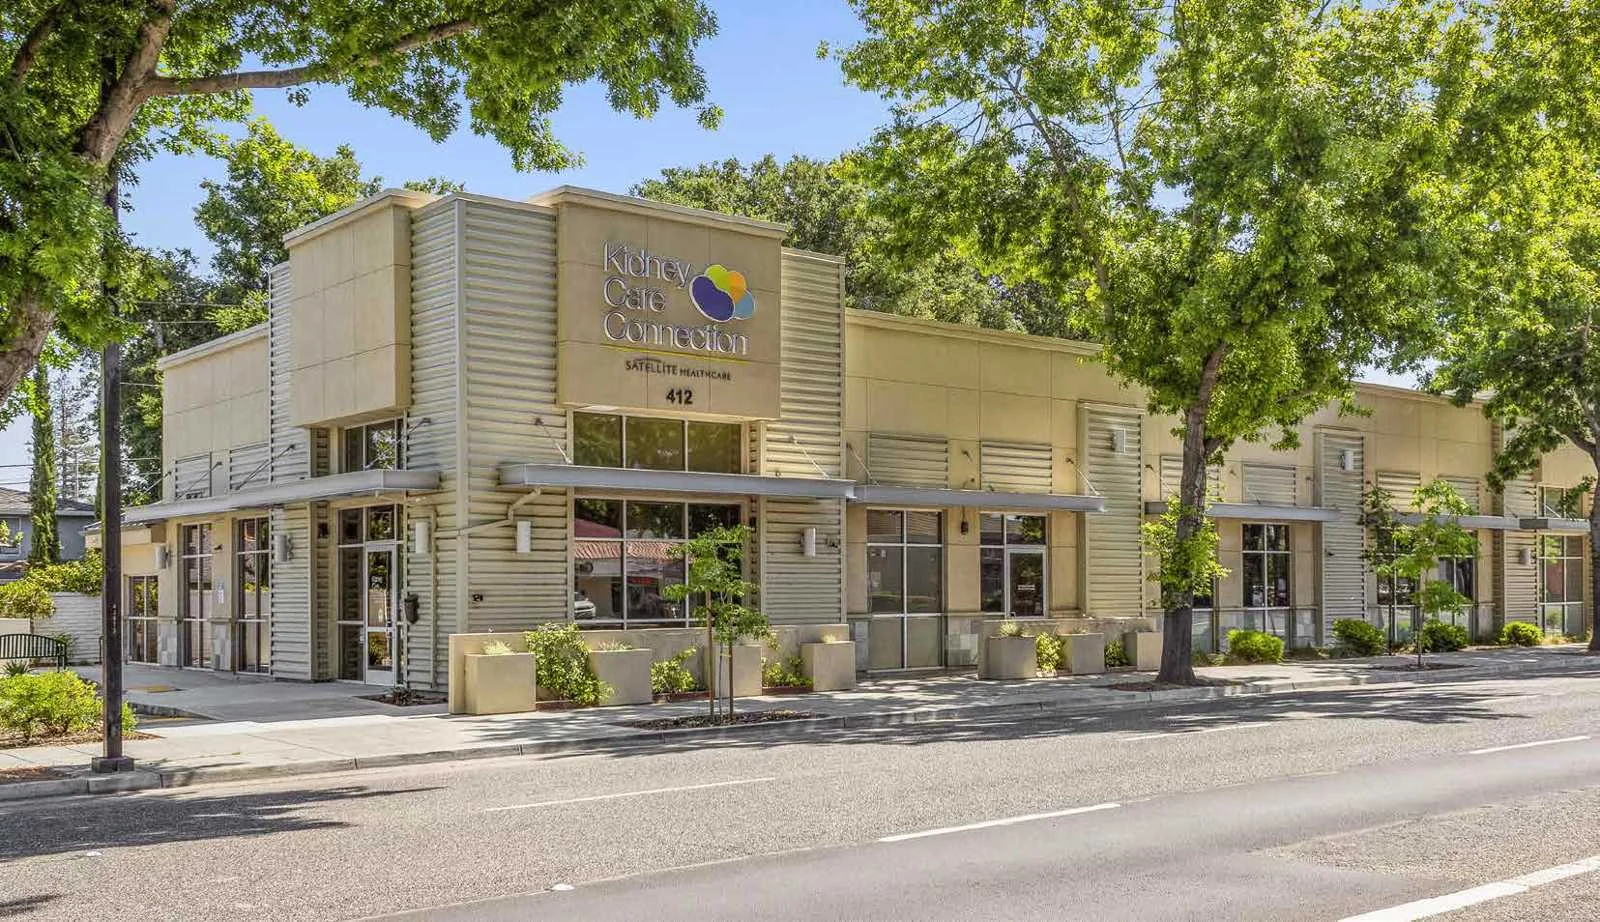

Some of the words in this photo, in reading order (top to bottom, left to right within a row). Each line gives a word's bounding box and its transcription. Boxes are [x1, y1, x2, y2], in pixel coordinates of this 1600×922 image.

[604, 242, 691, 289] Kidney
[603, 276, 666, 312] Care
[603, 311, 750, 355] Connection
[625, 361, 677, 376] SATELLITE
[679, 368, 732, 381] HEALTHCARE
[666, 388, 693, 405] 412
